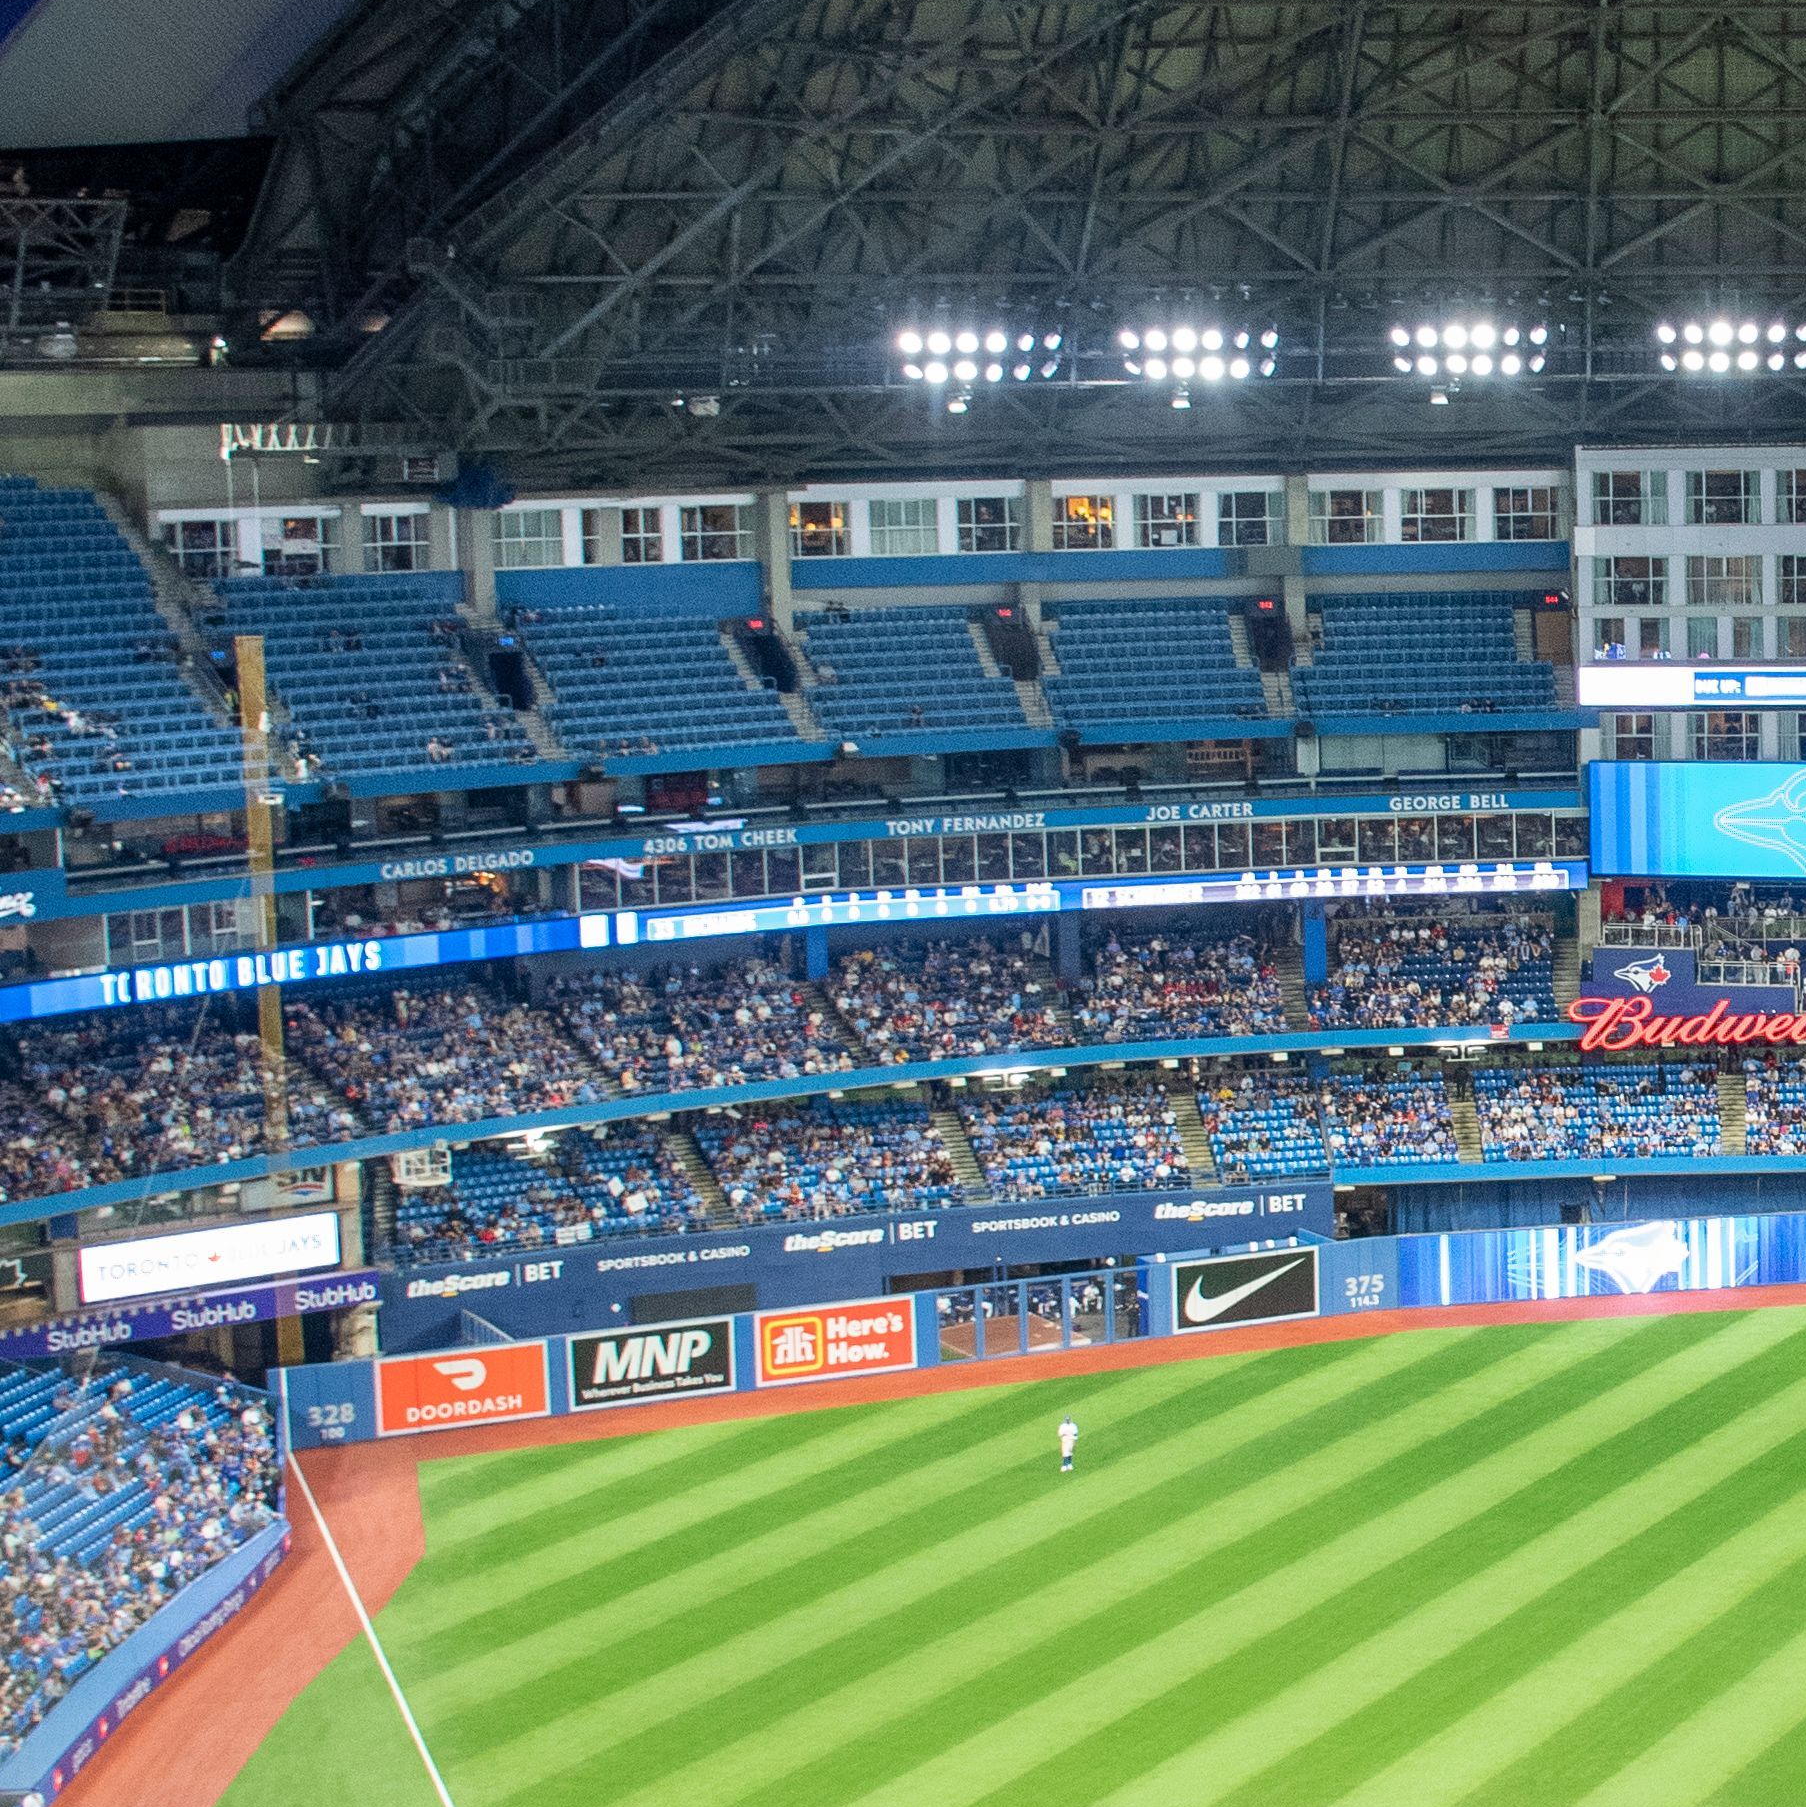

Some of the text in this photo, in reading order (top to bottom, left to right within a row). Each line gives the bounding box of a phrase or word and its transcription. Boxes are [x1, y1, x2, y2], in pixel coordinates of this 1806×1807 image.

[1145, 801, 1254, 821] JOE CARTER
[1389, 794, 1509, 812] GEORGE BELL
[885, 811, 1046, 837] TONY FERNANDEZ
[643, 826, 799, 854] 4306 TOM CHEEK
[381, 849, 535, 880] CARLOS DELGADO
[237, 949, 306, 988] BLUE
[314, 940, 383, 978] JAYS
[1154, 1193, 1307, 1222] theScore BET
[972, 1210, 1121, 1234] SPORTSBOOK & CASINO
[783, 1220, 938, 1253] theScore BET
[597, 1245, 751, 1272] SPORTSBOOK & CASINO
[407, 1259, 564, 1298] theScore BET
[1345, 1273, 1385, 1296] 375
[294, 1281, 376, 1311] StubHub
[171, 1301, 257, 1331] StubHub
[826, 1312, 904, 1340] Here's
[47, 1320, 132, 1352] StubHub
[592, 1330, 713, 1385] MNP
[826, 1341, 891, 1365] How.
[308, 1402, 355, 1427] 328
[406, 1394, 523, 1423] DOORDASH
